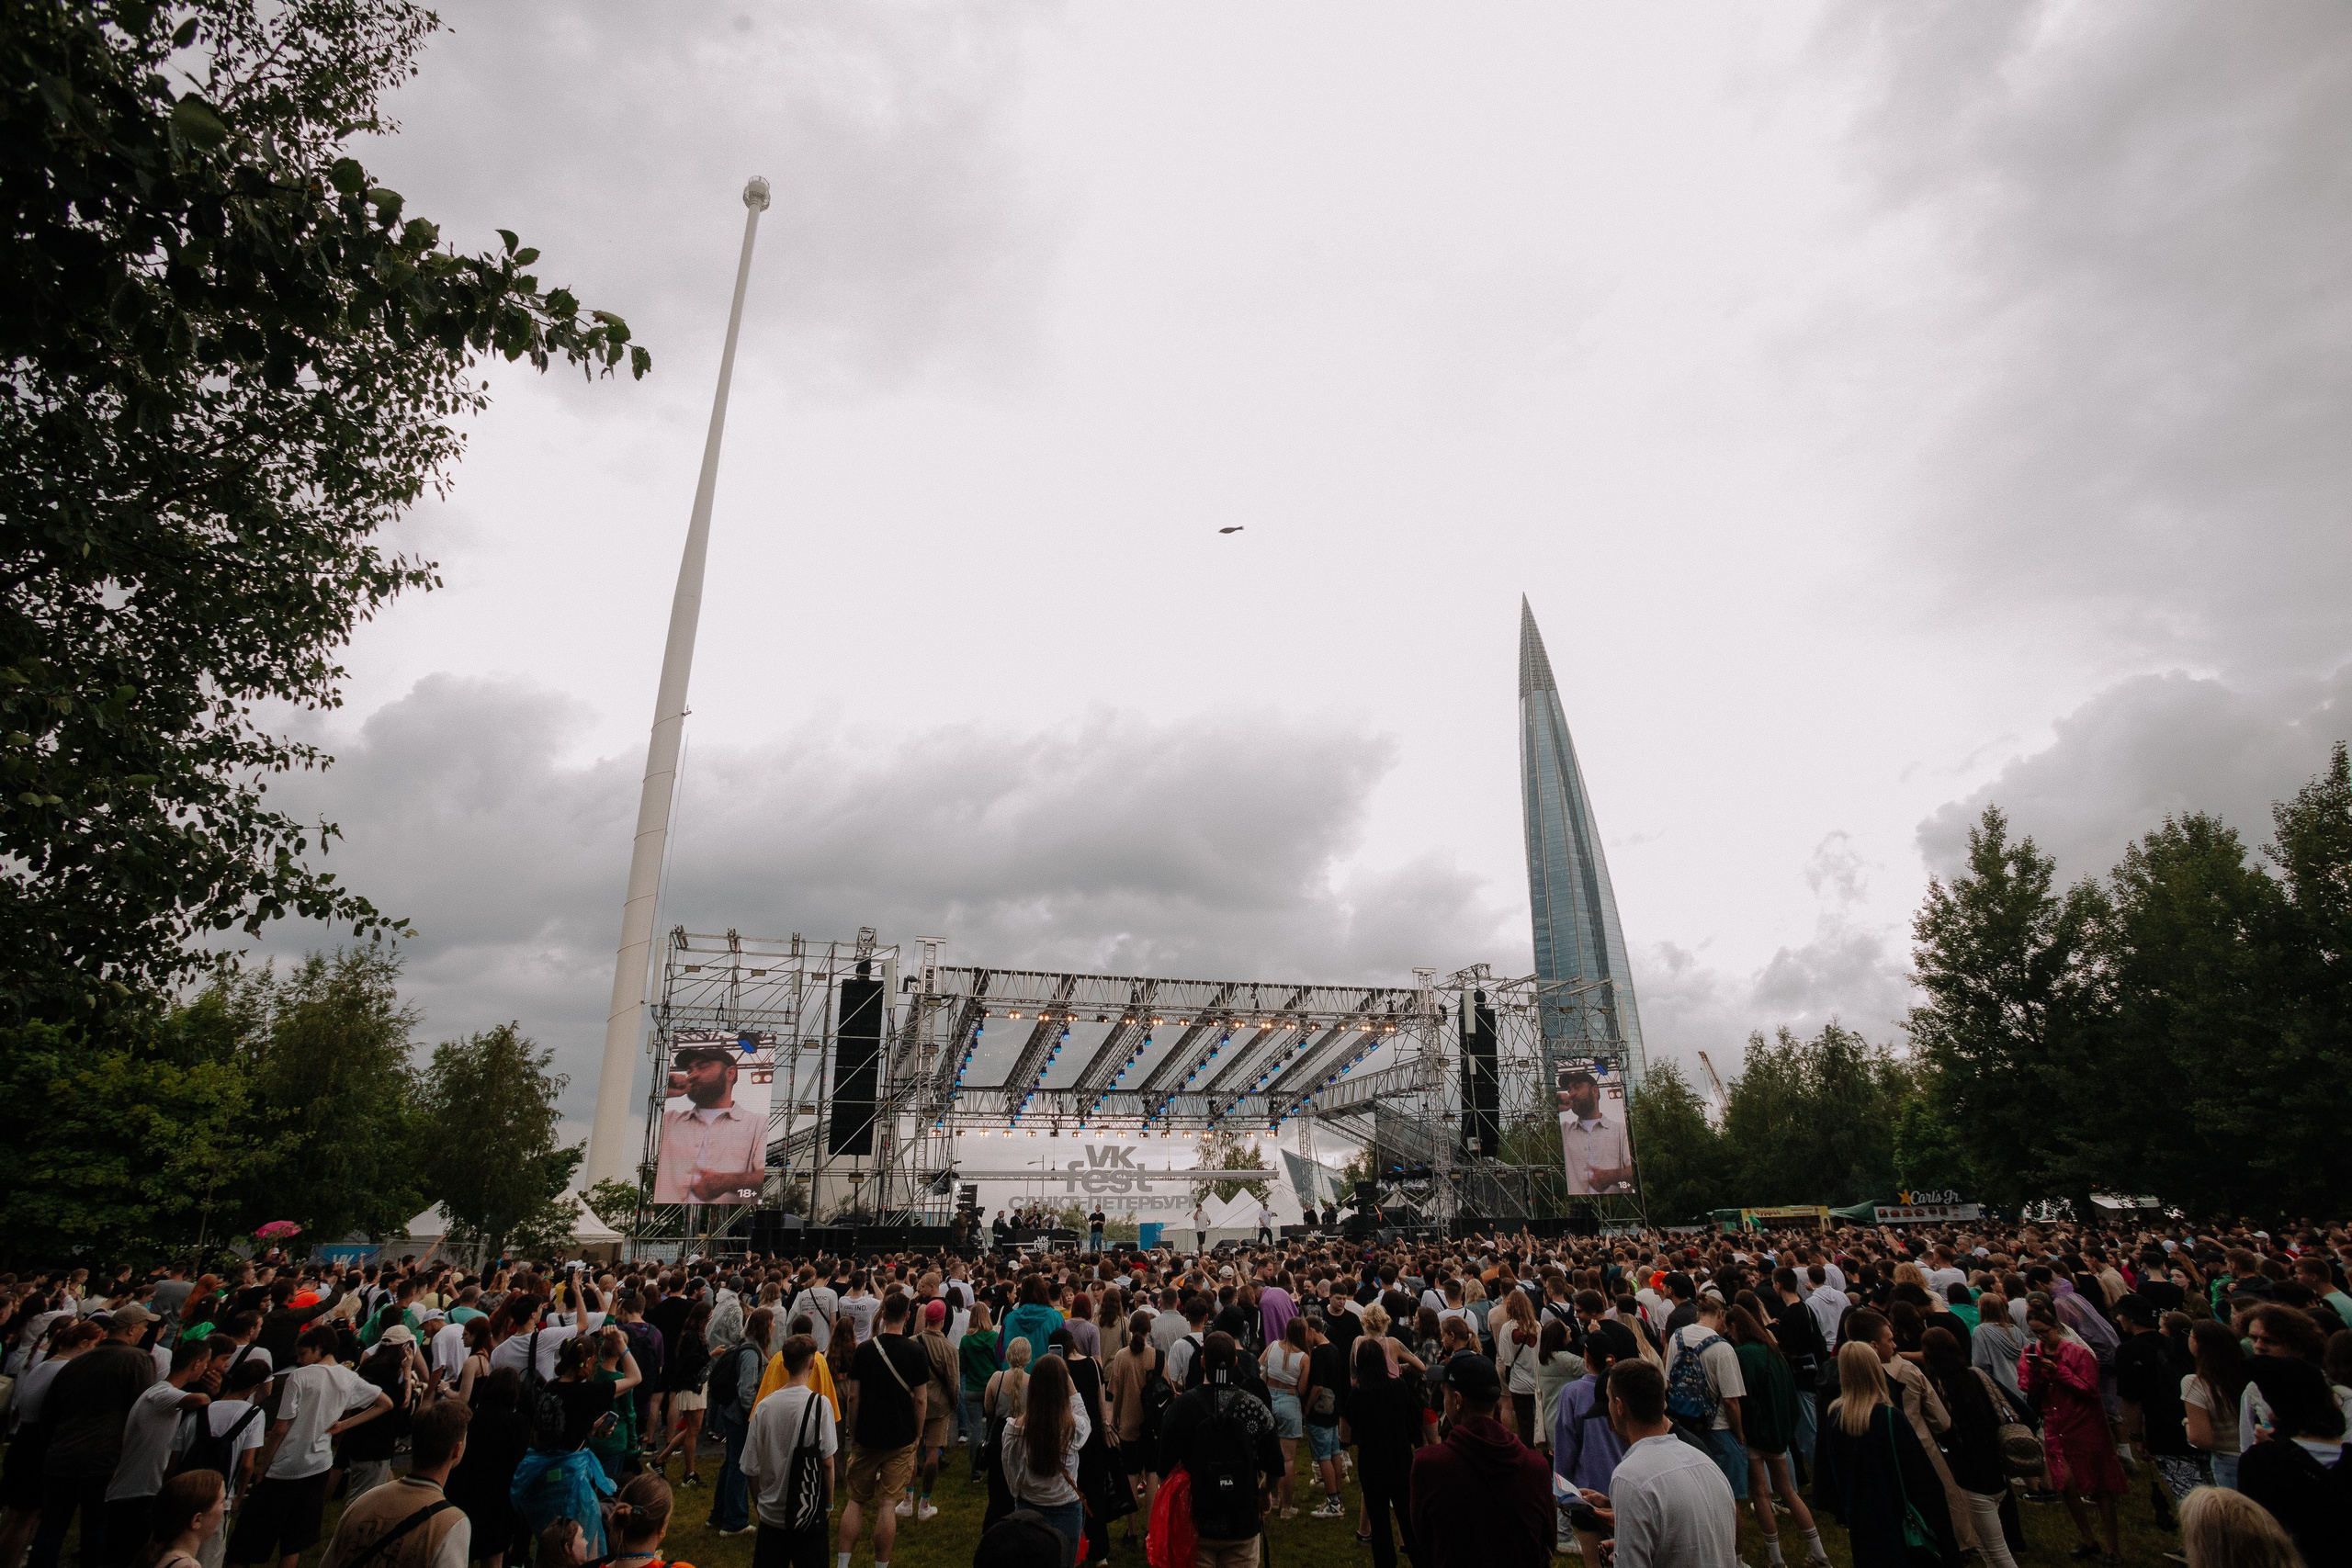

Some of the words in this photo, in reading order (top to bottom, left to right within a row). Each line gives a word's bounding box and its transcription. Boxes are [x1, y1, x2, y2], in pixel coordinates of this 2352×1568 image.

[1085, 1145, 1137, 1168] VK
[1066, 1160, 1153, 1193] fest
[1617, 1180, 1631, 1189] 18+
[737, 1189, 757, 1198] 18+
[1910, 1190, 1942, 1205] Carl's
[1943, 1190, 1962, 1204] Jr.
